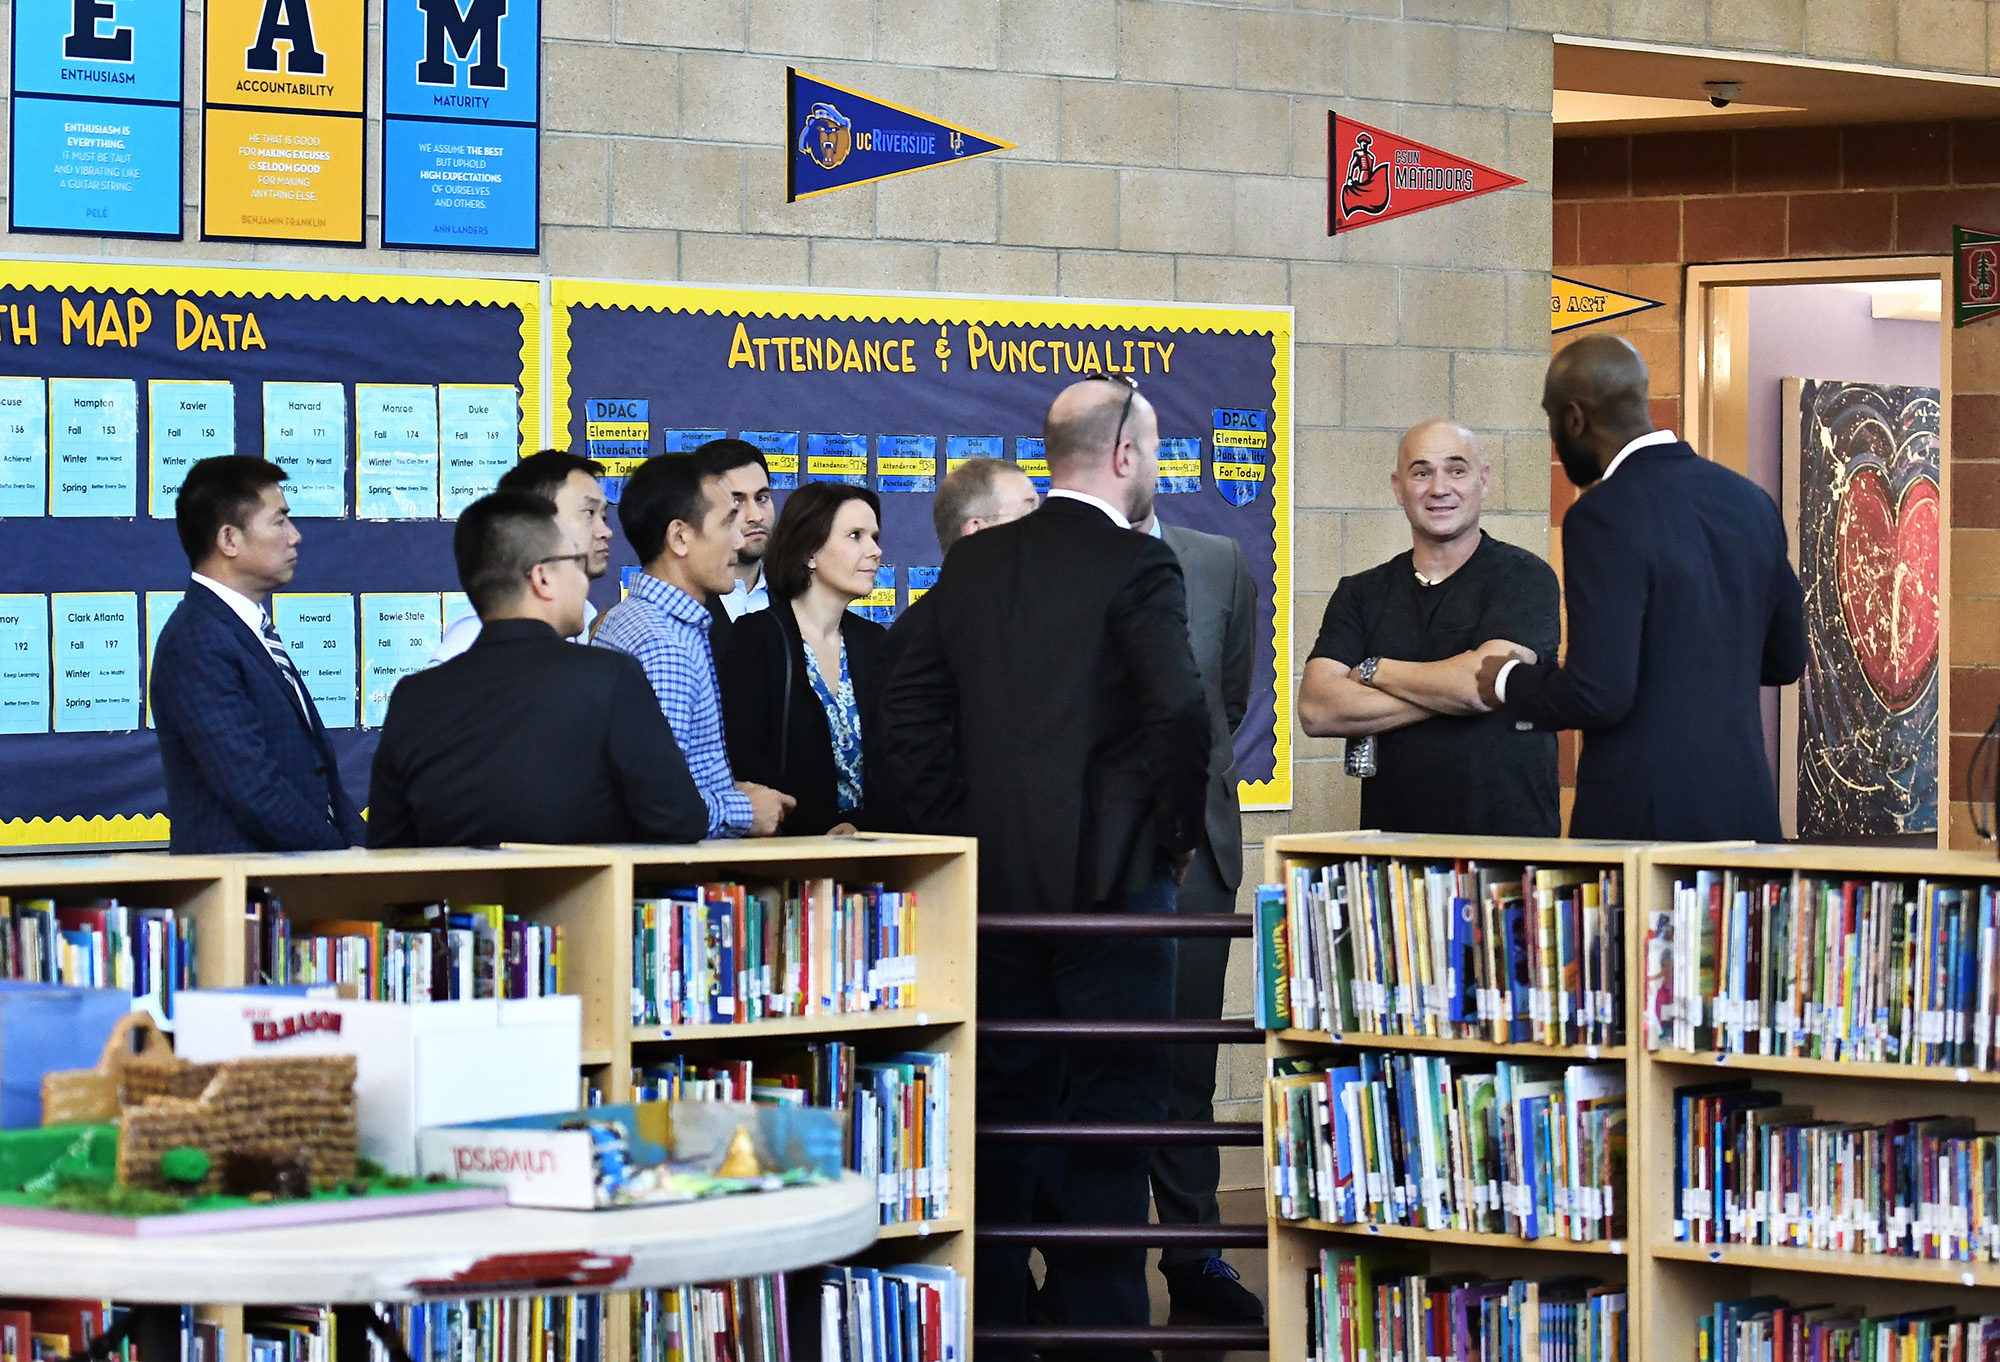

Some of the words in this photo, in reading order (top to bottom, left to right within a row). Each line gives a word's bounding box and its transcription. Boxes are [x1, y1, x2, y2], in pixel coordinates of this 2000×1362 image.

[63, 0, 134, 64] E
[245, 0, 326, 77] A
[416, 0, 508, 90] M
[61, 68, 136, 84] ENTHUSIASM
[236, 80, 334, 97] ACCOUNTABILITY
[433, 95, 490, 109] MATURITY
[64, 122, 121, 135] ENTHUSIASM
[122, 126, 131, 136] IS
[249, 134, 260, 143] HE
[262, 134, 283, 145] THAT
[285, 136, 292, 145] IS
[293, 136, 320, 147] GOOD
[239, 147, 256, 157] FOR
[258, 148, 292, 159] MAKING
[293, 150, 330, 161] EXCUSES
[418, 143, 432, 153] WE
[434, 144, 466, 155] ASSUME
[467, 146, 483, 156] THE
[484, 147, 504, 157] BEST
[62, 151, 70, 160] IT
[72, 152, 96, 162] MUST
[98, 153, 109, 163] BE
[110, 154, 131, 164] TAUT
[1395, 150, 1420, 164] CSUN
[248, 162, 256, 171] IS
[257, 162, 293, 173] SELDOM
[294, 163, 321, 174] GOOD
[436, 158, 452, 168] BUT
[453, 159, 487, 170] UPHOLD
[54, 164, 73, 175] AND
[75, 165, 120, 178] VIBRATING
[121, 168, 141, 179] LIKE
[420, 170, 441, 181] HIGH
[442, 172, 502, 183] EXPECTATIONS
[60, 179, 66, 189] A
[68, 179, 100, 191] GUITAR
[258, 175, 276, 186] FOR
[277, 176, 310, 187] MAKING
[1395, 167, 1475, 192] MATADORS
[251, 189, 294, 201] ANYTHING
[432, 184, 443, 194] OF
[445, 185, 490, 197] OURSELVES
[435, 198, 452, 208] AND
[86, 207, 108, 218] PELÉ
[241, 215, 284, 226] BENJAMIN
[285, 216, 326, 228] FRANKLIN
[433, 226, 451, 235] ANN
[452, 226, 489, 236] LANDERS
[1567, 296, 1605, 312] A&T
[62, 297, 152, 348] MAP
[176, 299, 267, 351] DATA
[727, 322, 916, 374] ATTENDANCE
[935, 325, 951, 372] &
[968, 326, 1175, 375] PUNCTUALITY
[74, 398, 114, 410] Hampton
[180, 401, 207, 410] Xavier
[289, 402, 321, 411] Harvard
[383, 404, 413, 413] Monroe
[469, 405, 489, 414] Duke
[597, 402, 637, 418] DPAC
[1222, 412, 1257, 427] DPAC
[10, 425, 25, 434] 156
[68, 426, 82, 435] Fall
[102, 426, 116, 435] 153
[168, 428, 181, 437] Fall
[201, 428, 215, 437] 150
[281, 428, 293, 436] Fall
[313, 428, 325, 437] 171
[374, 431, 387, 439] Fall
[589, 425, 647, 440] Elementary
[455, 432, 468, 440] Fall
[487, 432, 499, 440] 169
[1216, 433, 1266, 448] Elementary
[589, 443, 648, 455] Attendance
[823, 447, 852, 457] University
[62, 455, 87, 463] Winter
[162, 457, 187, 466] Winter
[275, 456, 299, 464] Winter
[369, 458, 392, 466] Winter
[451, 459, 474, 467] Winter
[1219, 467, 1232, 476] For
[1236, 467, 1261, 480] Today
[62, 483, 87, 494] Spring
[369, 486, 392, 495] Spring
[451, 486, 474, 495] Spring
[68, 613, 91, 622] Clark
[94, 613, 124, 622] Atlanta
[300, 613, 331, 622] Howard
[380, 612, 403, 621] Bowie
[405, 612, 425, 620] State
[15, 642, 28, 650] 192
[71, 641, 84, 649] Fall
[105, 640, 118, 648] 197
[291, 641, 304, 649] Fall
[323, 640, 336, 648] 203
[379, 639, 391, 647] Fall
[410, 638, 423, 646] 200
[65, 670, 90, 678] Winter
[373, 667, 396, 675] Winter
[65, 698, 91, 708] Spring
